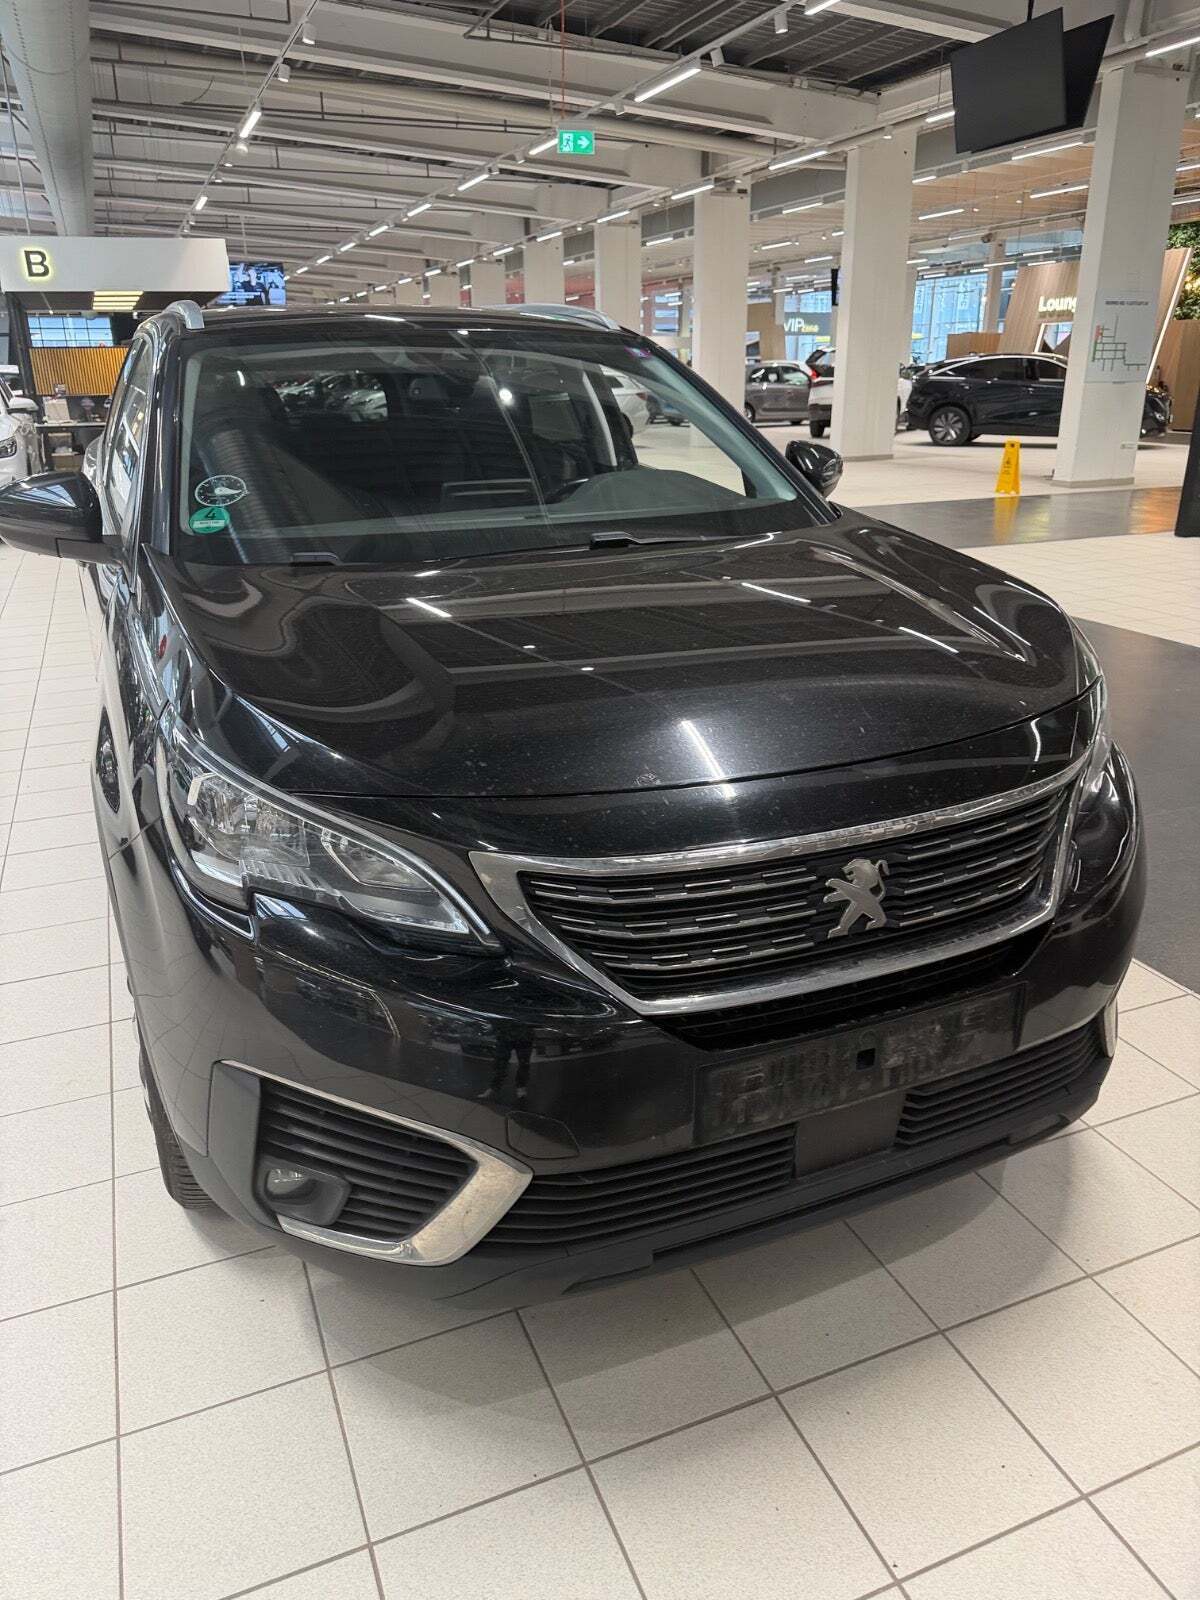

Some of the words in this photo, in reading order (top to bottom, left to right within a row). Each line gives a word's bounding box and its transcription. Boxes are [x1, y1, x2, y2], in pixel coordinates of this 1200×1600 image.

[24, 250, 50, 277] B
[783, 317, 805, 332] VIP
[204, 507, 217, 520] 4
